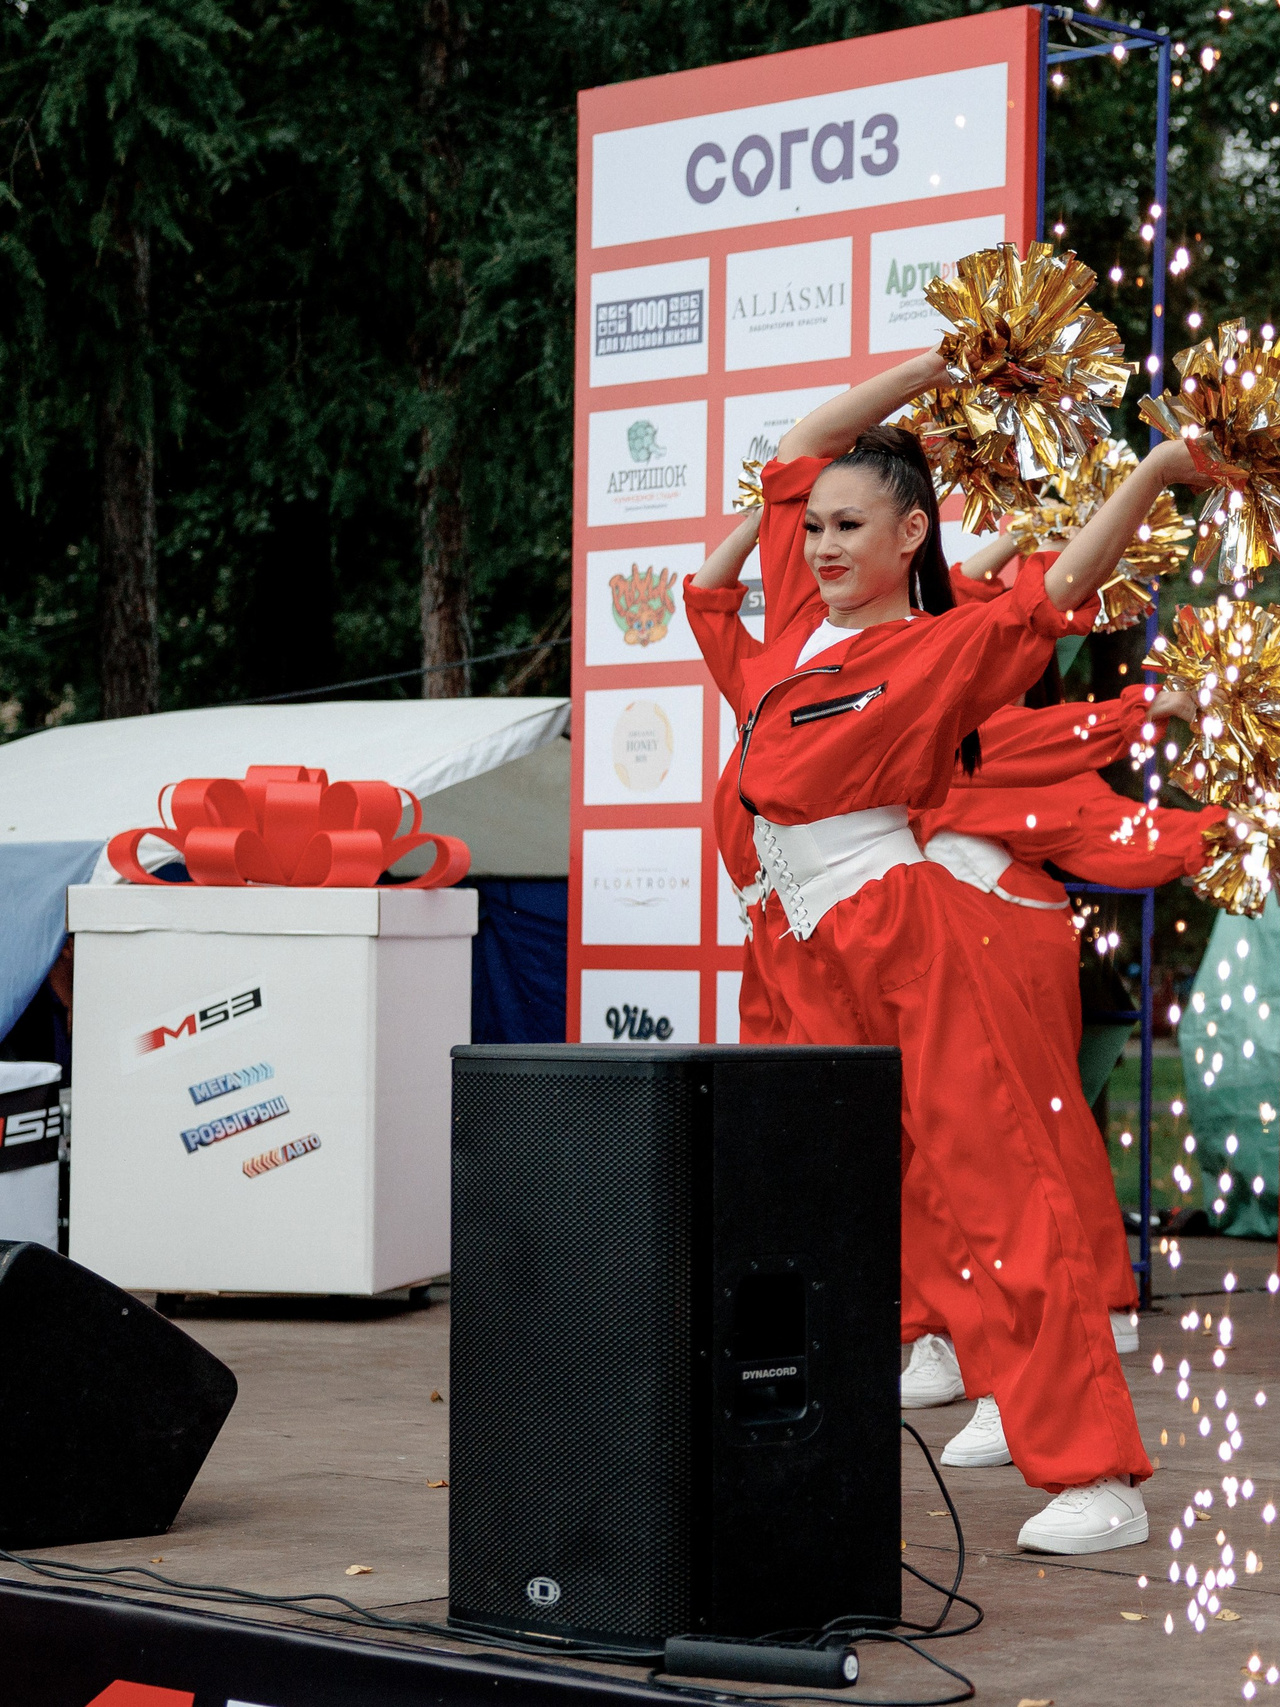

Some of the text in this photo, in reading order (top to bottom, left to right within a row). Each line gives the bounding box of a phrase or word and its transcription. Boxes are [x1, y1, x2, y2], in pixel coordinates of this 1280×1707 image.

[628, 298, 669, 333] 1000
[731, 281, 846, 321] ALJÁSMI
[606, 463, 688, 495] АРТИШОК
[592, 876, 691, 891] FLOATROOM
[605, 1004, 674, 1041] Vibe
[190, 1072, 243, 1105] МЕГА
[181, 1095, 290, 1154] РОЗЫГРЫШ
[285, 1132, 322, 1162] АВТО
[742, 1366, 798, 1381] DYNACORD
